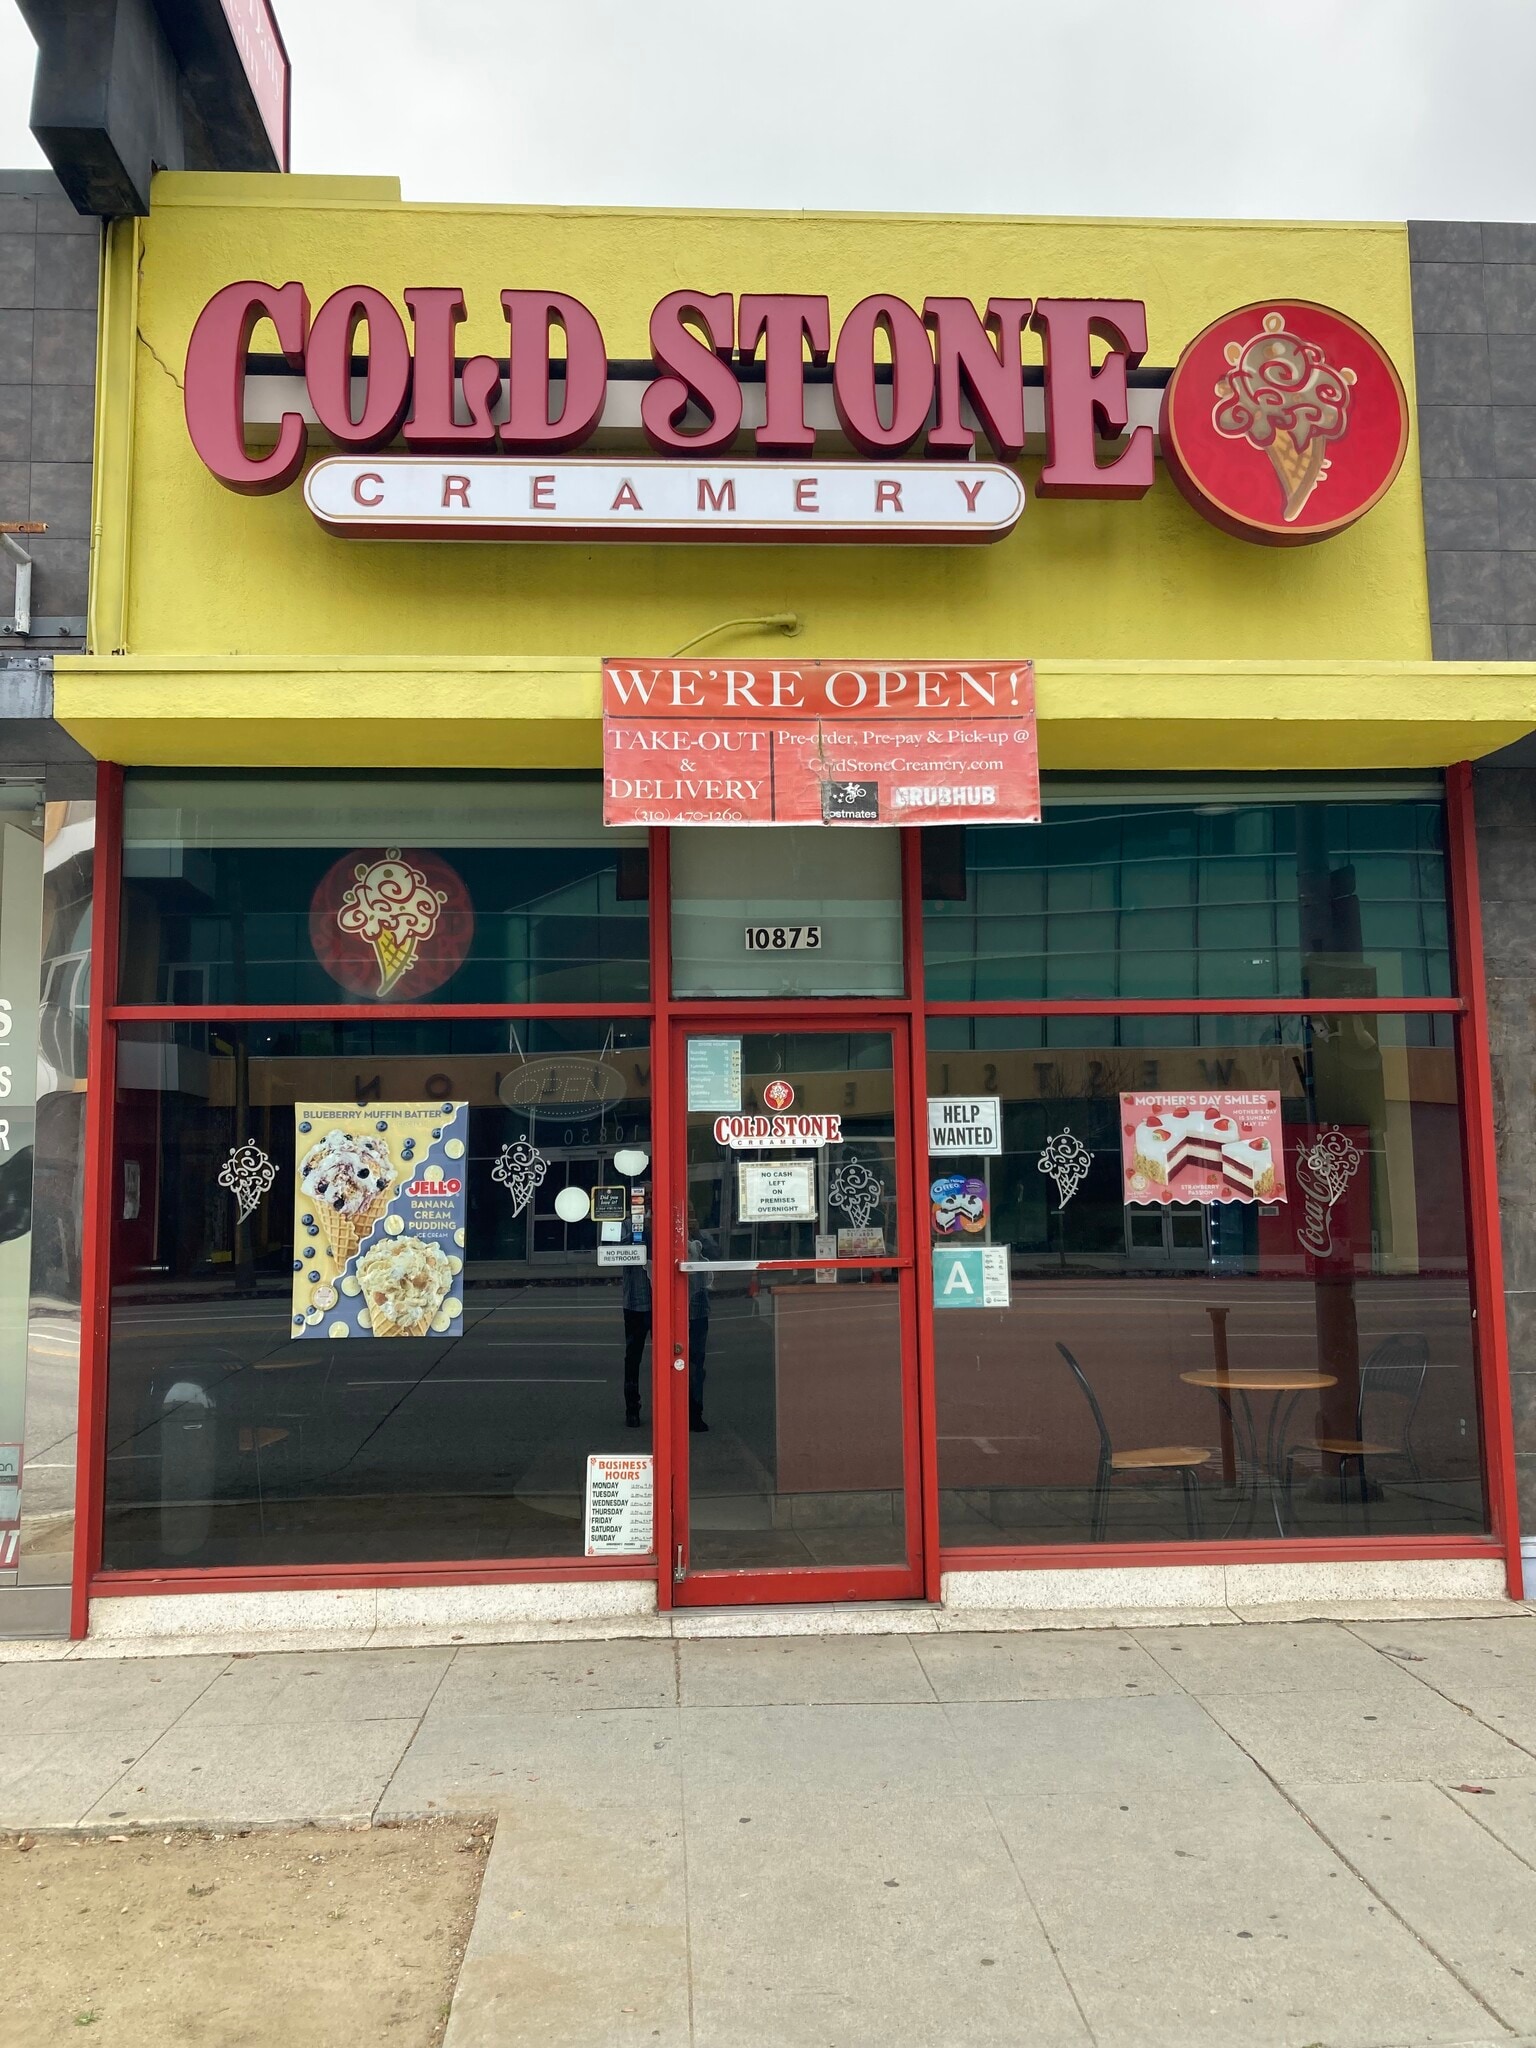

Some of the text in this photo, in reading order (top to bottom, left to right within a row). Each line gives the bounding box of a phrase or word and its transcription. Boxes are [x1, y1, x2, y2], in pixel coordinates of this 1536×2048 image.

[184, 280, 1156, 499] COLD STONE
[353, 473, 986, 513] CREAMERY
[607, 668, 1020, 708] WE'RE OPEN!
[607, 729, 766, 751] TAKE-OUT
[863, 731, 922, 747] Pre-pay
[927, 731, 944, 743] &
[948, 729, 1009, 746] Pick-up
[1013, 730, 1030, 744] @
[680, 758, 697, 772] &
[610, 779, 765, 800] DELIVERY
[634, 808, 742, 823] (310) 470-1260
[825, 809, 878, 819] ostmates
[746, 927, 820, 949] 10875
[513, 1075, 610, 1104] OPEN
[1135, 1094, 1267, 1106] MOTHER'S DAY SMILES
[303, 1110, 442, 1119] BLUEBERRY MUFFIN BATTER
[943, 1104, 980, 1124] HELP
[715, 1116, 840, 1143] COLD STONE
[933, 1126, 993, 1146] WANTED
[411, 1200, 455, 1209] BANANA
[414, 1211, 451, 1219] CREAM
[408, 1221, 457, 1230] PUDDING
[943, 1261, 975, 1295] A
[605, 1471, 640, 1480] HOURS
[591, 1534, 616, 1542] SUNDAY
